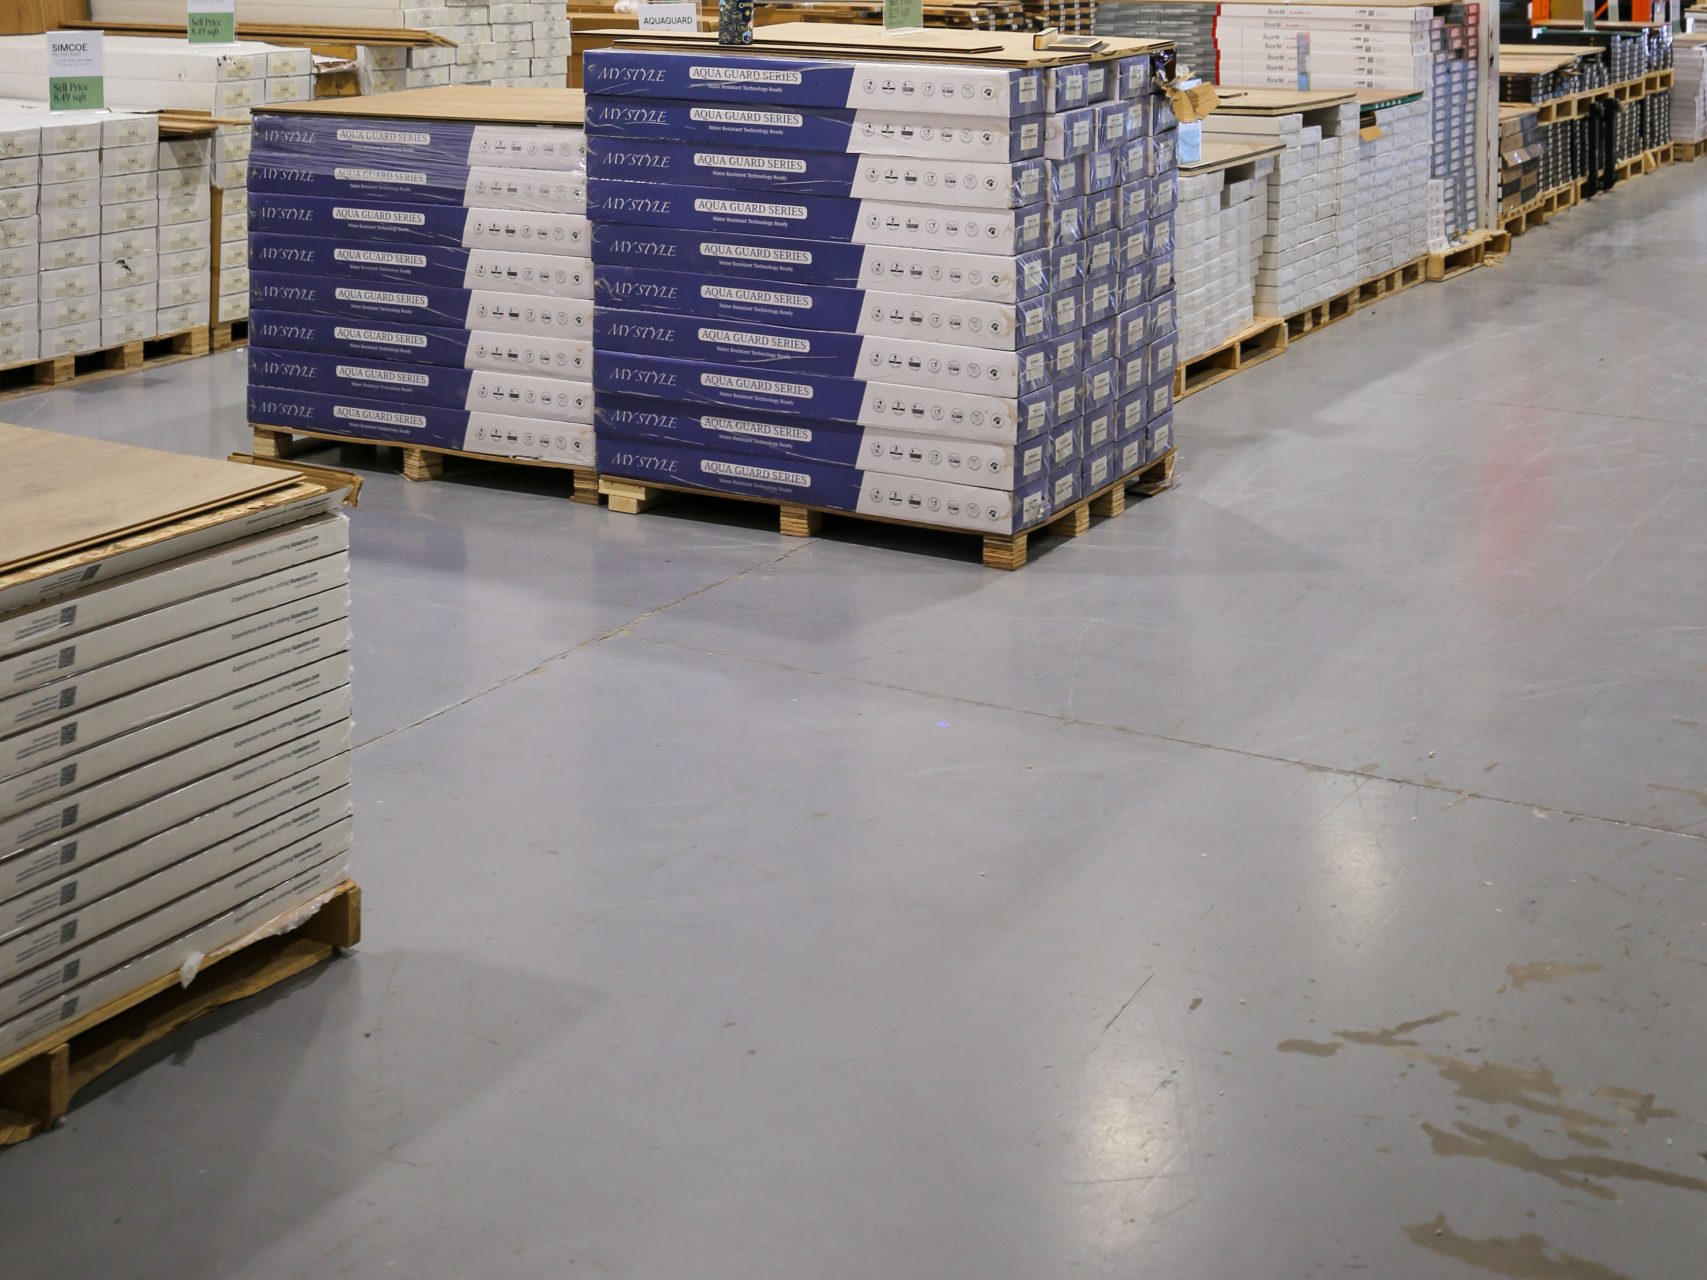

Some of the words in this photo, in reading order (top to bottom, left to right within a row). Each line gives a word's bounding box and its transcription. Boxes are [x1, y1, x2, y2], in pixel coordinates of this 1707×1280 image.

[205, 18, 221, 26] Price
[643, 16, 693, 25] AQUAGUARD
[52, 44, 88, 52] SIMCOE
[694, 68, 721, 78] AQUA
[724, 70, 760, 81] GUARD
[763, 72, 798, 83] SERIES
[53, 83, 67, 92] Sell
[69, 82, 89, 92] Price
[694, 109, 722, 119] AQUA
[725, 111, 761, 122] GUARD
[764, 113, 799, 124] SERIES
[698, 154, 726, 165] AQUA
[729, 157, 764, 168] GUARD
[768, 159, 802, 170] SERIES
[336, 209, 359, 219] AQUA
[362, 210, 391, 220] GUARD
[394, 213, 422, 223] SERIES
[699, 200, 727, 211] AQUA
[730, 202, 765, 214] GUARD
[768, 205, 804, 217] SERIES
[337, 250, 360, 260] AQUA
[363, 252, 393, 262] GUARD
[395, 254, 424, 265] SERIES
[704, 244, 732, 255] AQUA
[735, 247, 770, 258] GUARD
[773, 250, 808, 262] SERIES
[339, 289, 362, 300] AQUA
[364, 291, 394, 302] GUARD
[397, 294, 425, 305] SERIES
[705, 287, 733, 298] AQUA
[736, 290, 771, 302] GUARD
[774, 293, 809, 306] SERIES
[338, 328, 361, 339] AQUA
[364, 331, 393, 342] GUARD
[396, 334, 424, 345] SERIES
[703, 330, 730, 341] AQUA
[733, 333, 768, 346] GUARD
[771, 337, 806, 350] SERIES
[339, 367, 363, 378] AQUA
[365, 369, 395, 381] GUARD
[398, 373, 426, 384] SERIES
[705, 375, 733, 386] AQUA
[736, 379, 772, 391] GUARD
[774, 383, 809, 396] SERIES
[337, 407, 360, 419] AQUA
[363, 410, 392, 422] GUARD
[395, 414, 423, 425] SERIES
[705, 418, 732, 429] AQUA
[736, 422, 771, 435] GUARD
[774, 426, 808, 439] SERIES
[705, 461, 732, 473] AQUA
[735, 465, 770, 479] GUARD
[773, 470, 807, 484] SERIES
